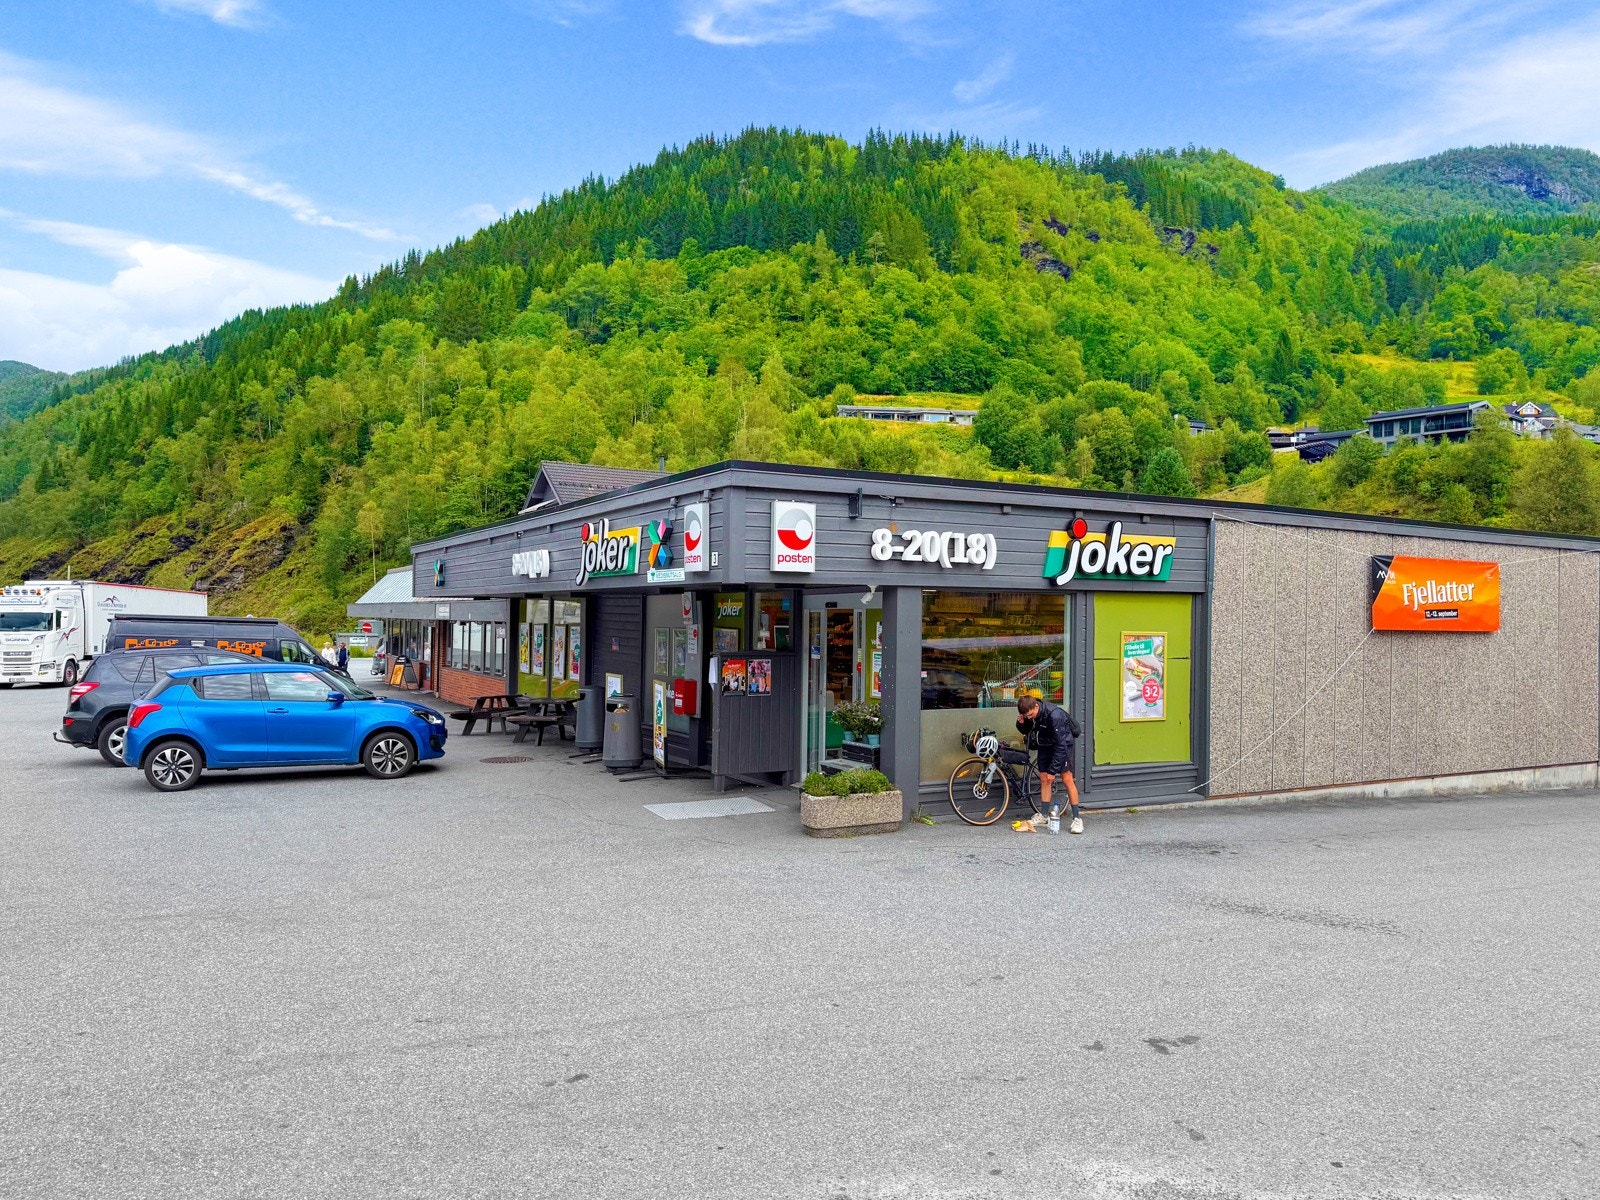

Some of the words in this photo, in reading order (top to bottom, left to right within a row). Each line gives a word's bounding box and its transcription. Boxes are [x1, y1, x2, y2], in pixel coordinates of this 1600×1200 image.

[575, 517, 633, 587] joker
[777, 552, 813, 565] posten
[871, 527, 998, 570] 8-20(18)
[1053, 517, 1174, 586] joker
[717, 598, 744, 620] joker
[1402, 579, 1474, 611] Fjellatter
[1438, 609, 1458, 618] september
